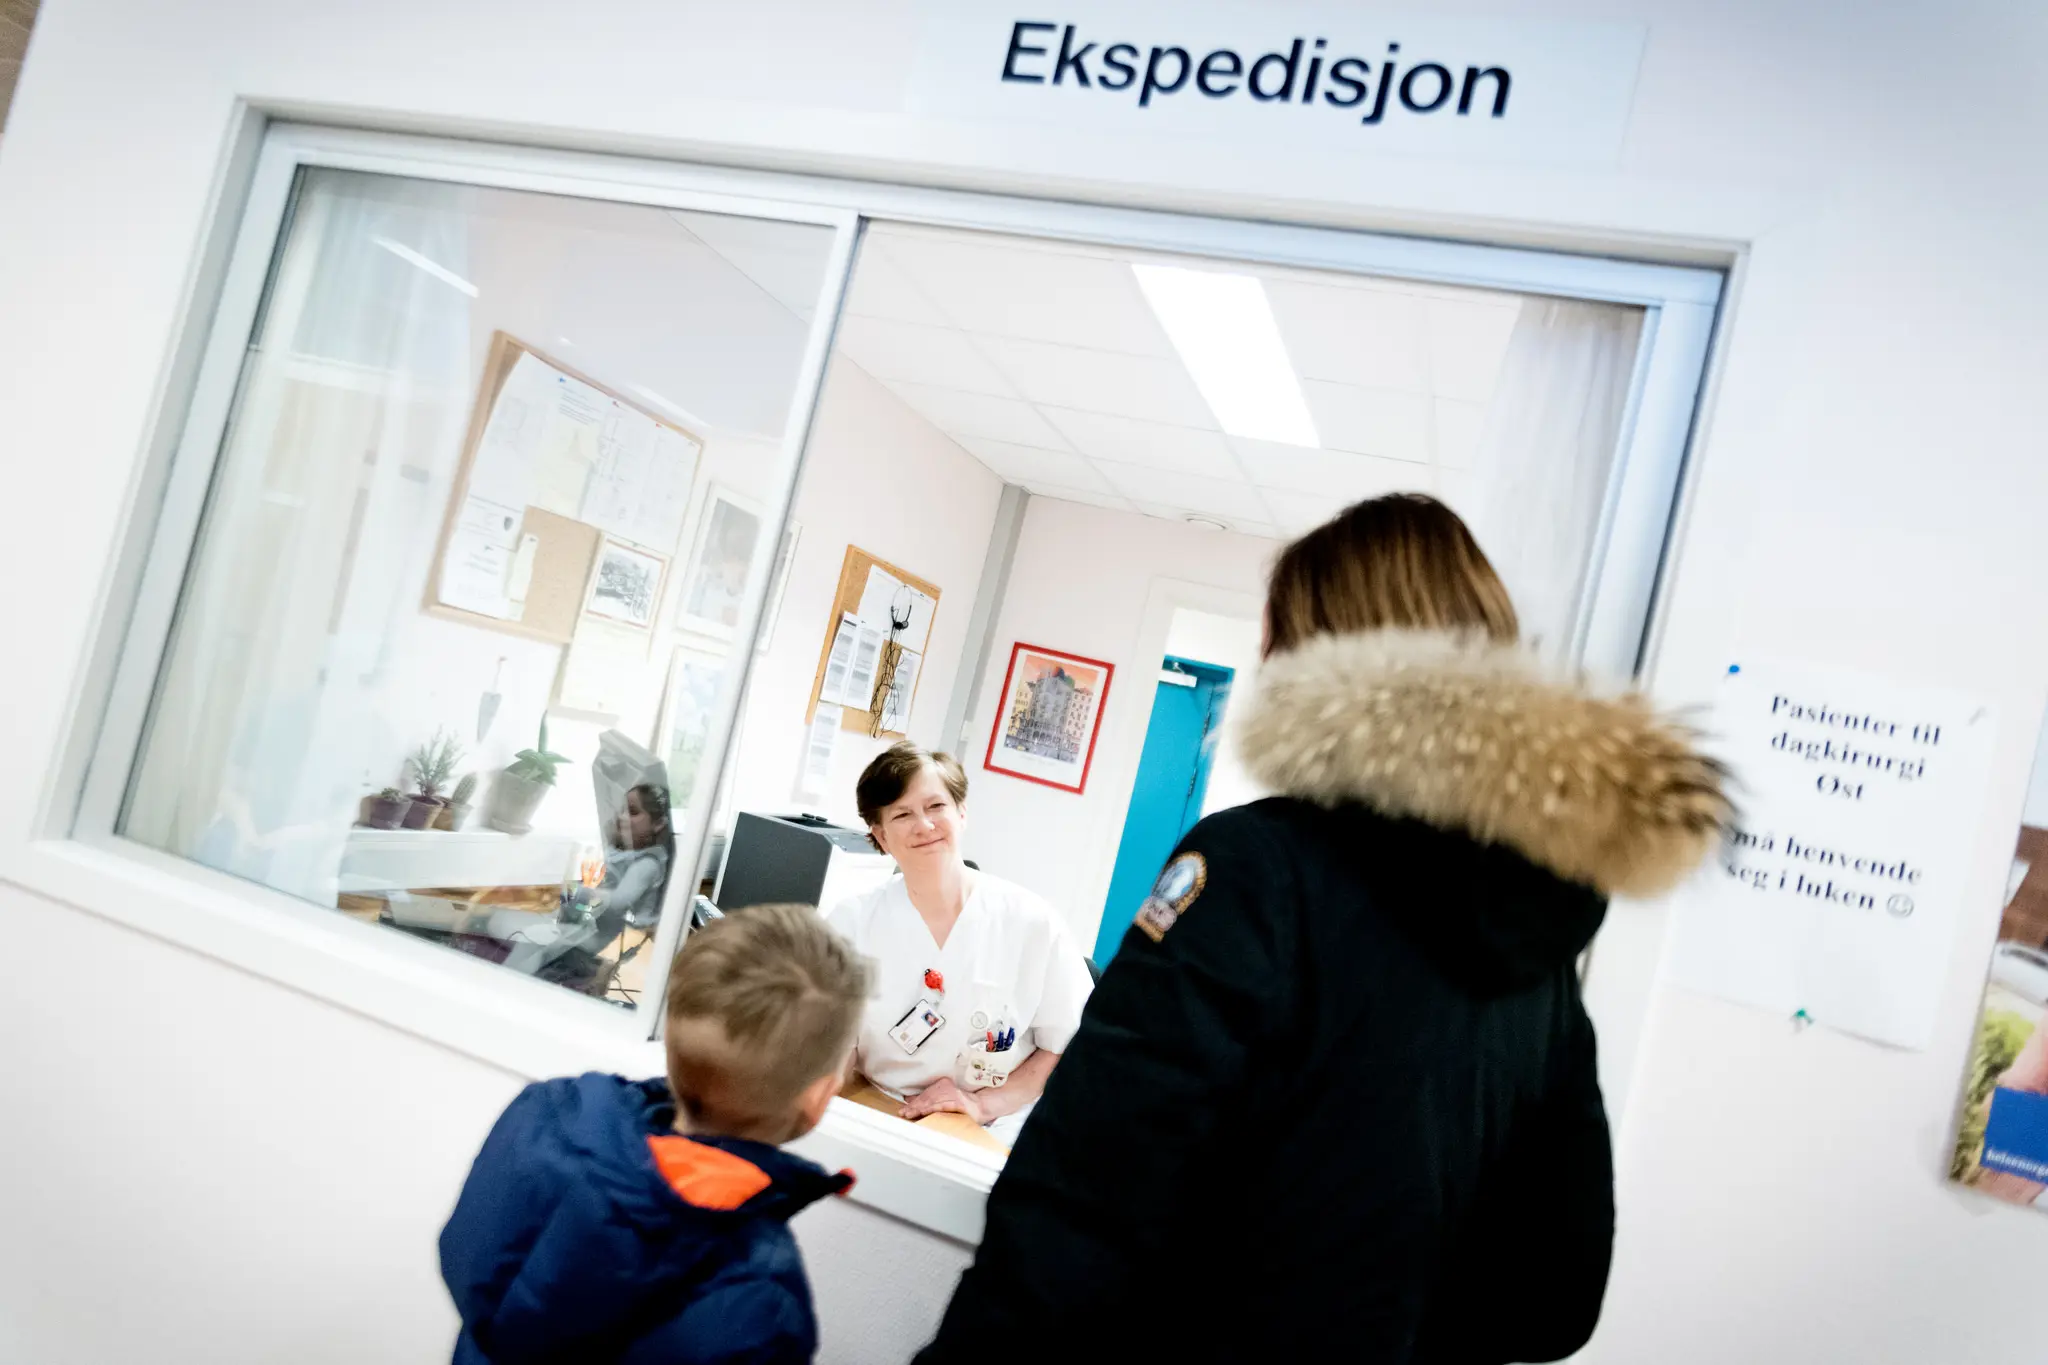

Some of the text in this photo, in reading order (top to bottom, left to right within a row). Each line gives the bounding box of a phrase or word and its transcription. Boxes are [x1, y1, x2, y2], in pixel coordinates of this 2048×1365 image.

[1001, 21, 1513, 126] Ekspedisjon
[1771, 695, 1941, 746] Pasienter til
[1771, 731, 1926, 781] dagkirurgi
[1785, 836, 1923, 887] henvende
[1727, 863, 1876, 912] seg i luken
